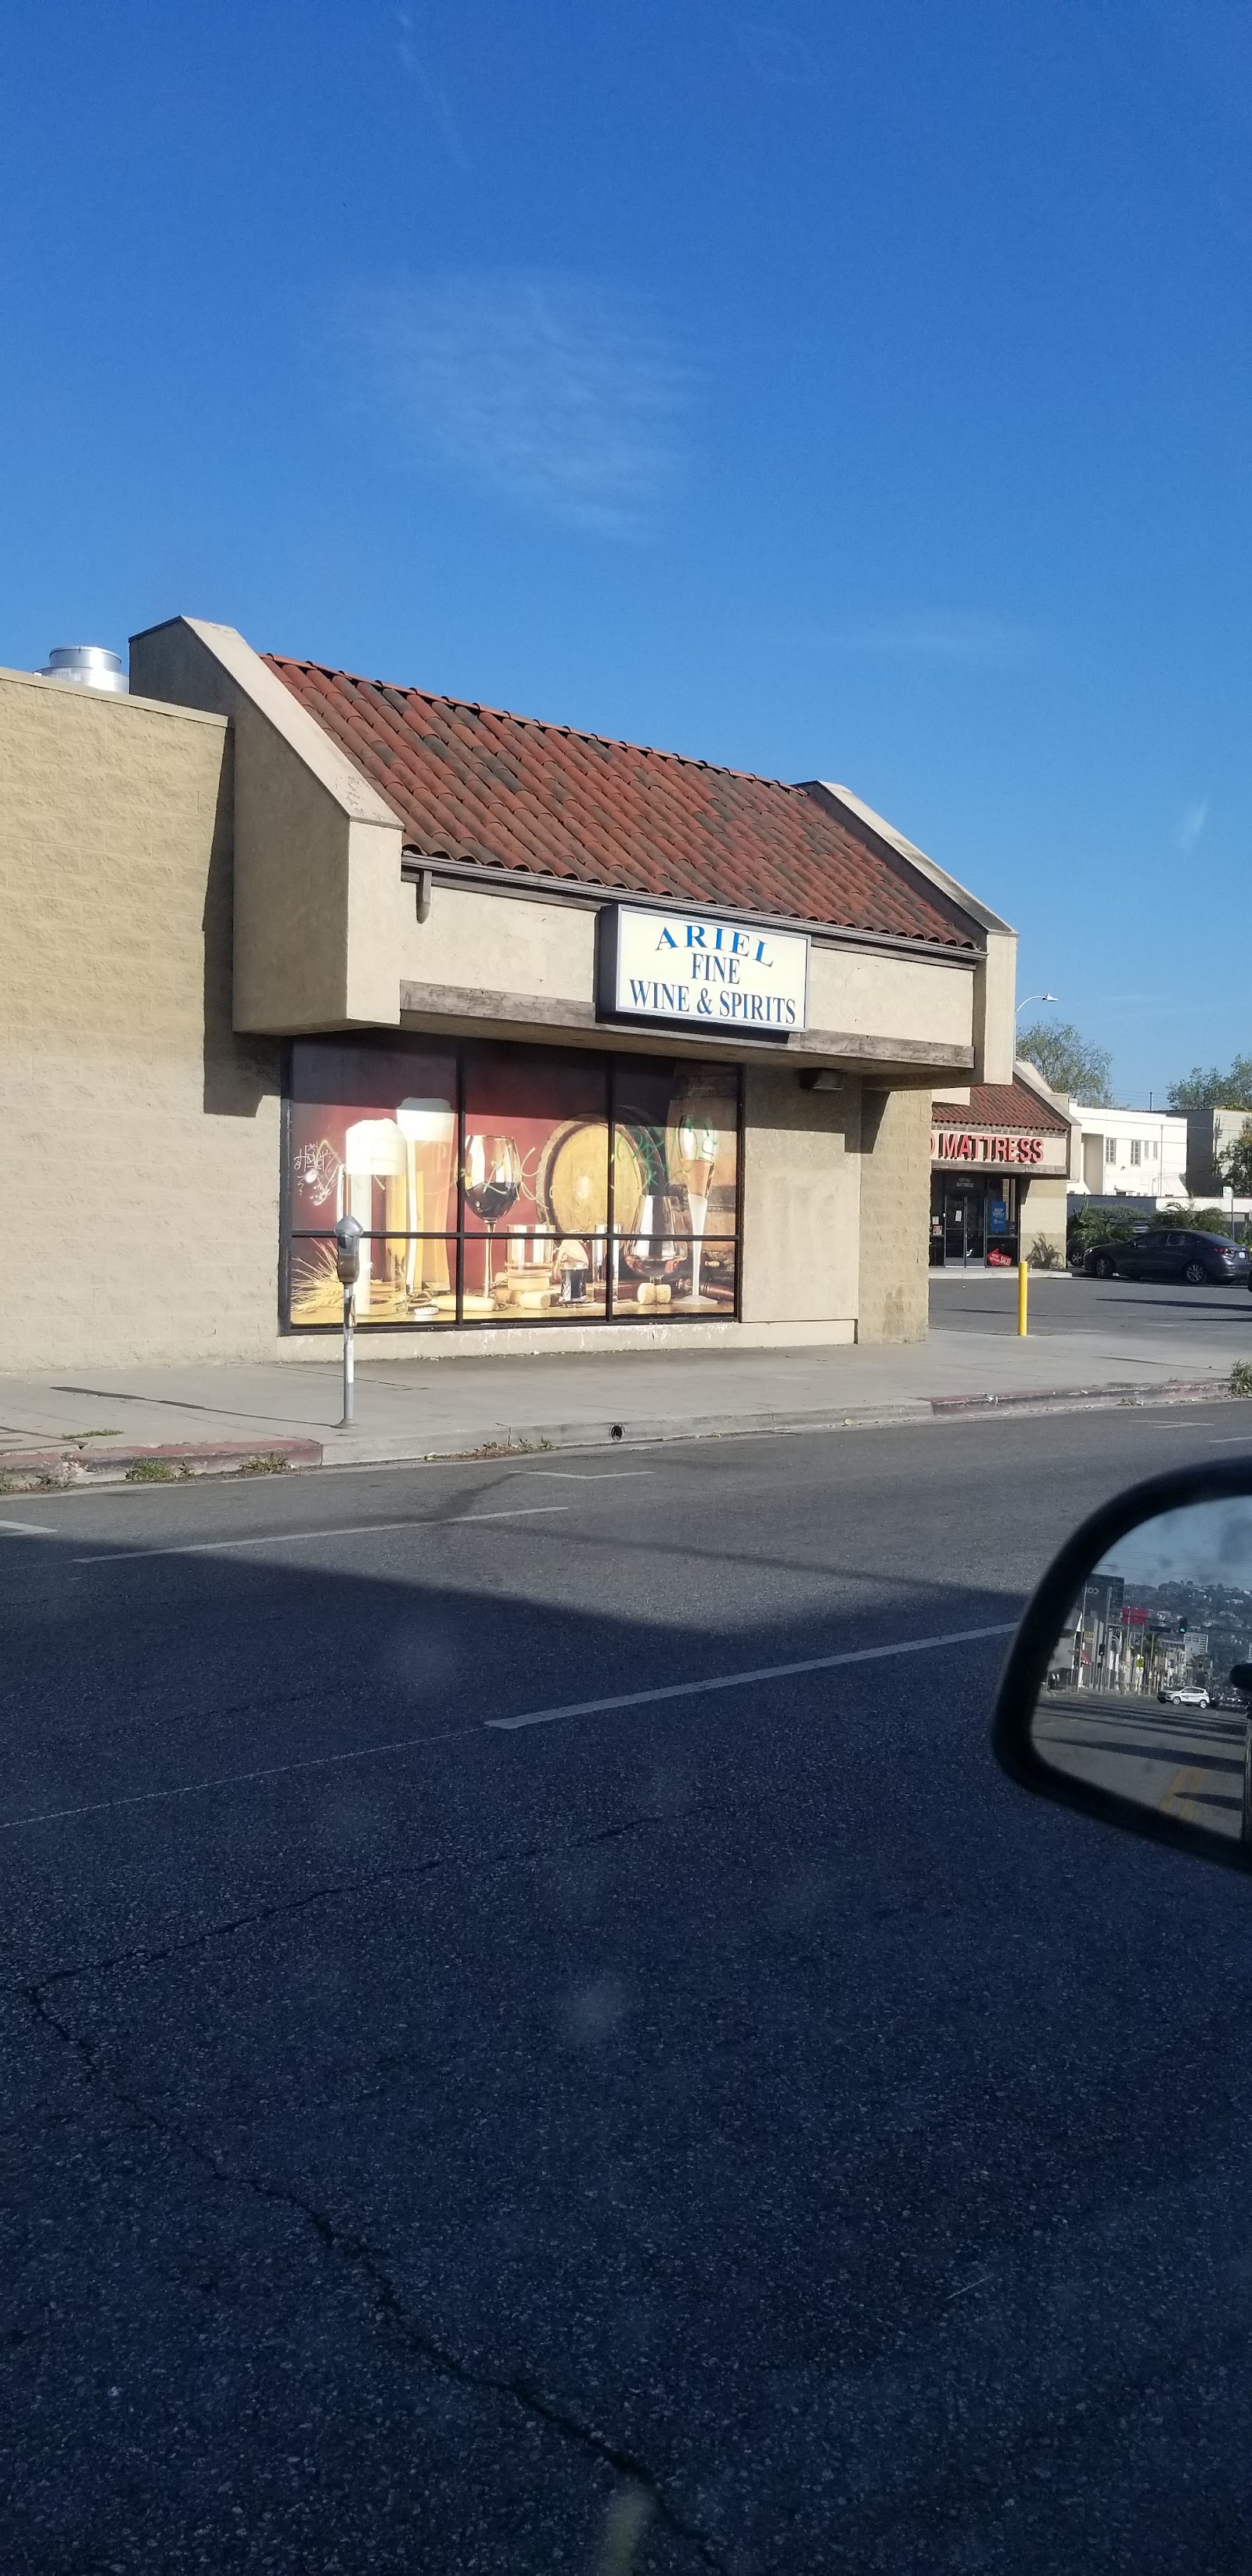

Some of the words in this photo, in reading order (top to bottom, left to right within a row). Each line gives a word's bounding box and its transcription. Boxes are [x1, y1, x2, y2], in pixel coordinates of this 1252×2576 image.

[655, 924, 773, 967] ARIEL
[691, 952, 740, 985] FINE
[629, 979, 689, 1012] WINE
[696, 988, 712, 1015] &
[719, 990, 796, 1025] SPIRITS
[939, 1133, 1044, 1163] MATTRESS
